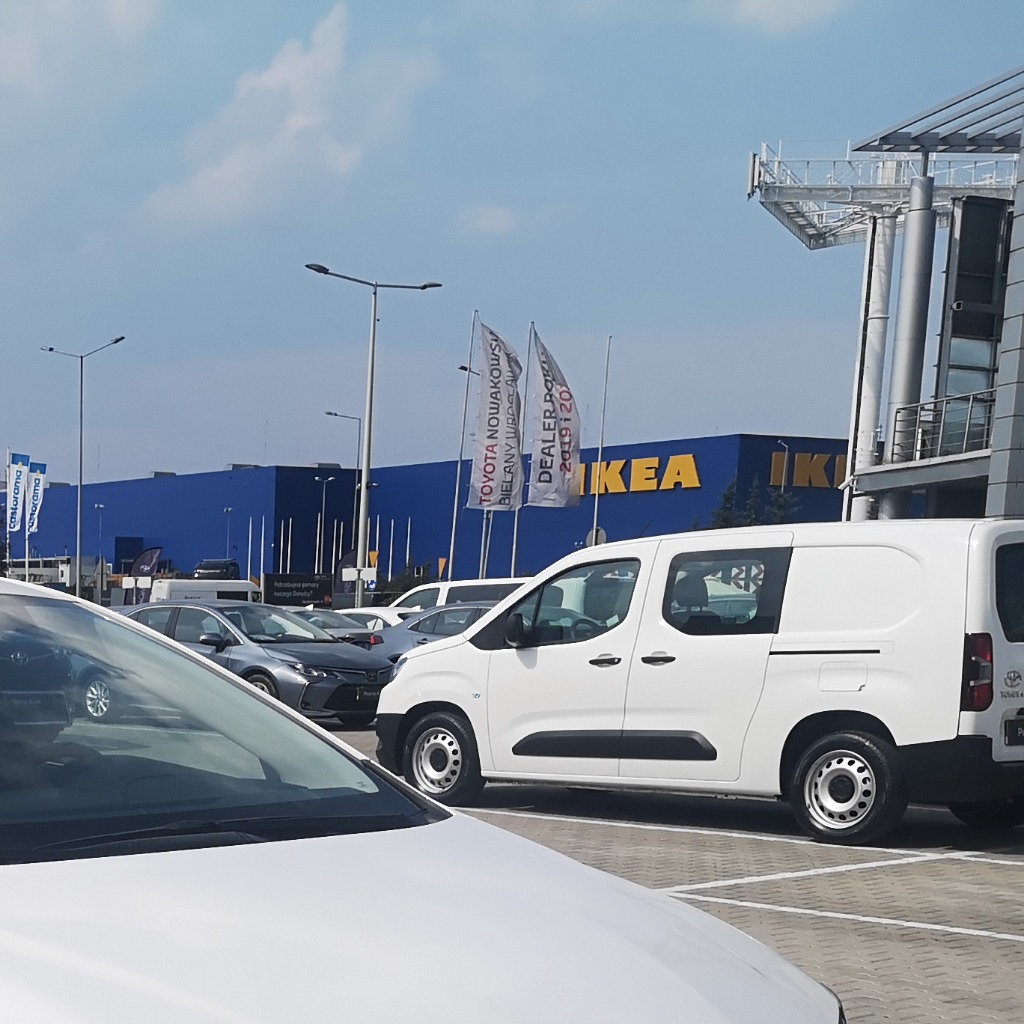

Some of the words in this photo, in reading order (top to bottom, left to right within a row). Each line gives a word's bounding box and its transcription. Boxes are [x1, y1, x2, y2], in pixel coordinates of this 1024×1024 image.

[486, 332, 501, 440] NOWAKOWS
[479, 444, 497, 505] TOYOTA
[497, 445, 516, 506] BIELANY
[538, 409, 556, 484] DEALER
